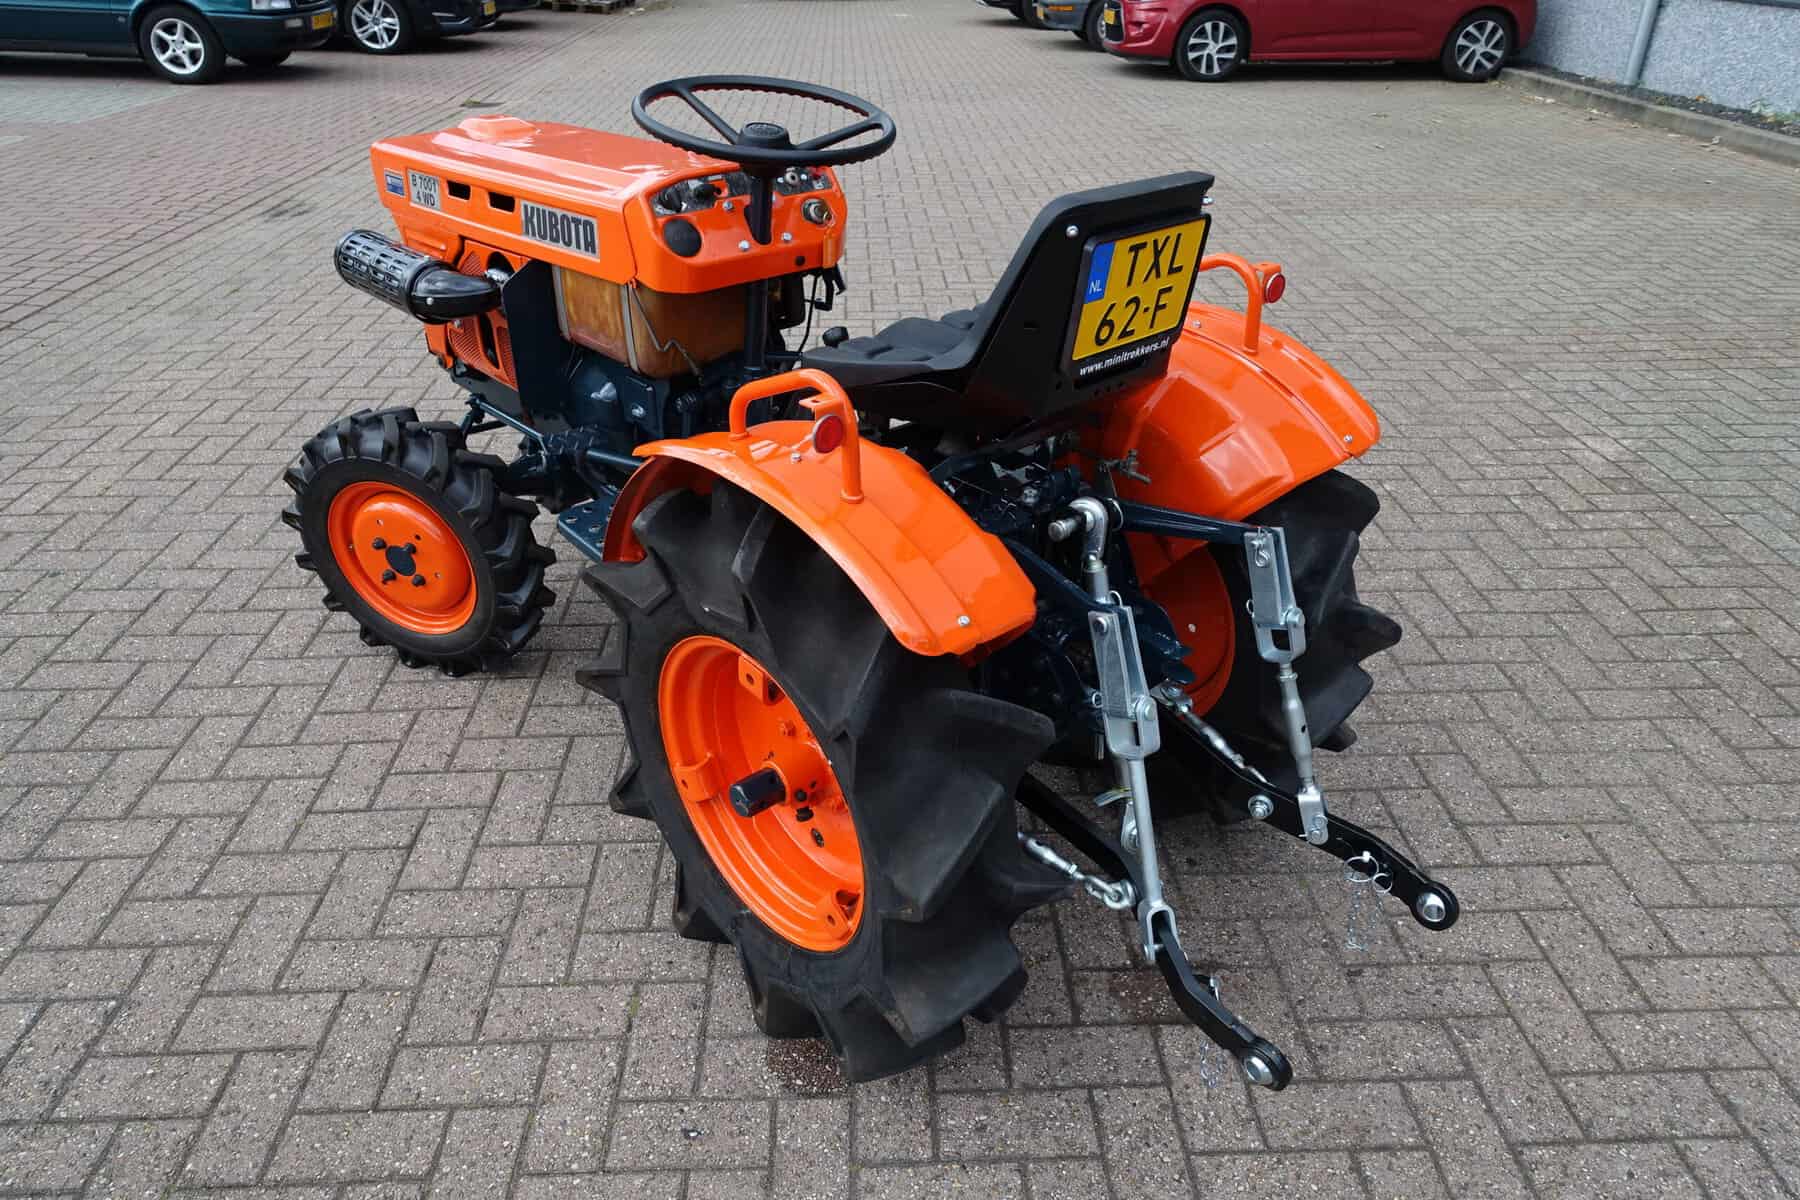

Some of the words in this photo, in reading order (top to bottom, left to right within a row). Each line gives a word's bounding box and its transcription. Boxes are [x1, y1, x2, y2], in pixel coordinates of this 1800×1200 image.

[415, 190, 422, 203] 4
[419, 175, 437, 193] 7001
[523, 203, 597, 254] KUBOTA
[1126, 232, 1184, 287] TXL
[1088, 279, 1103, 294] NL
[1080, 336, 1171, 376] www.minitrekkers.nl
